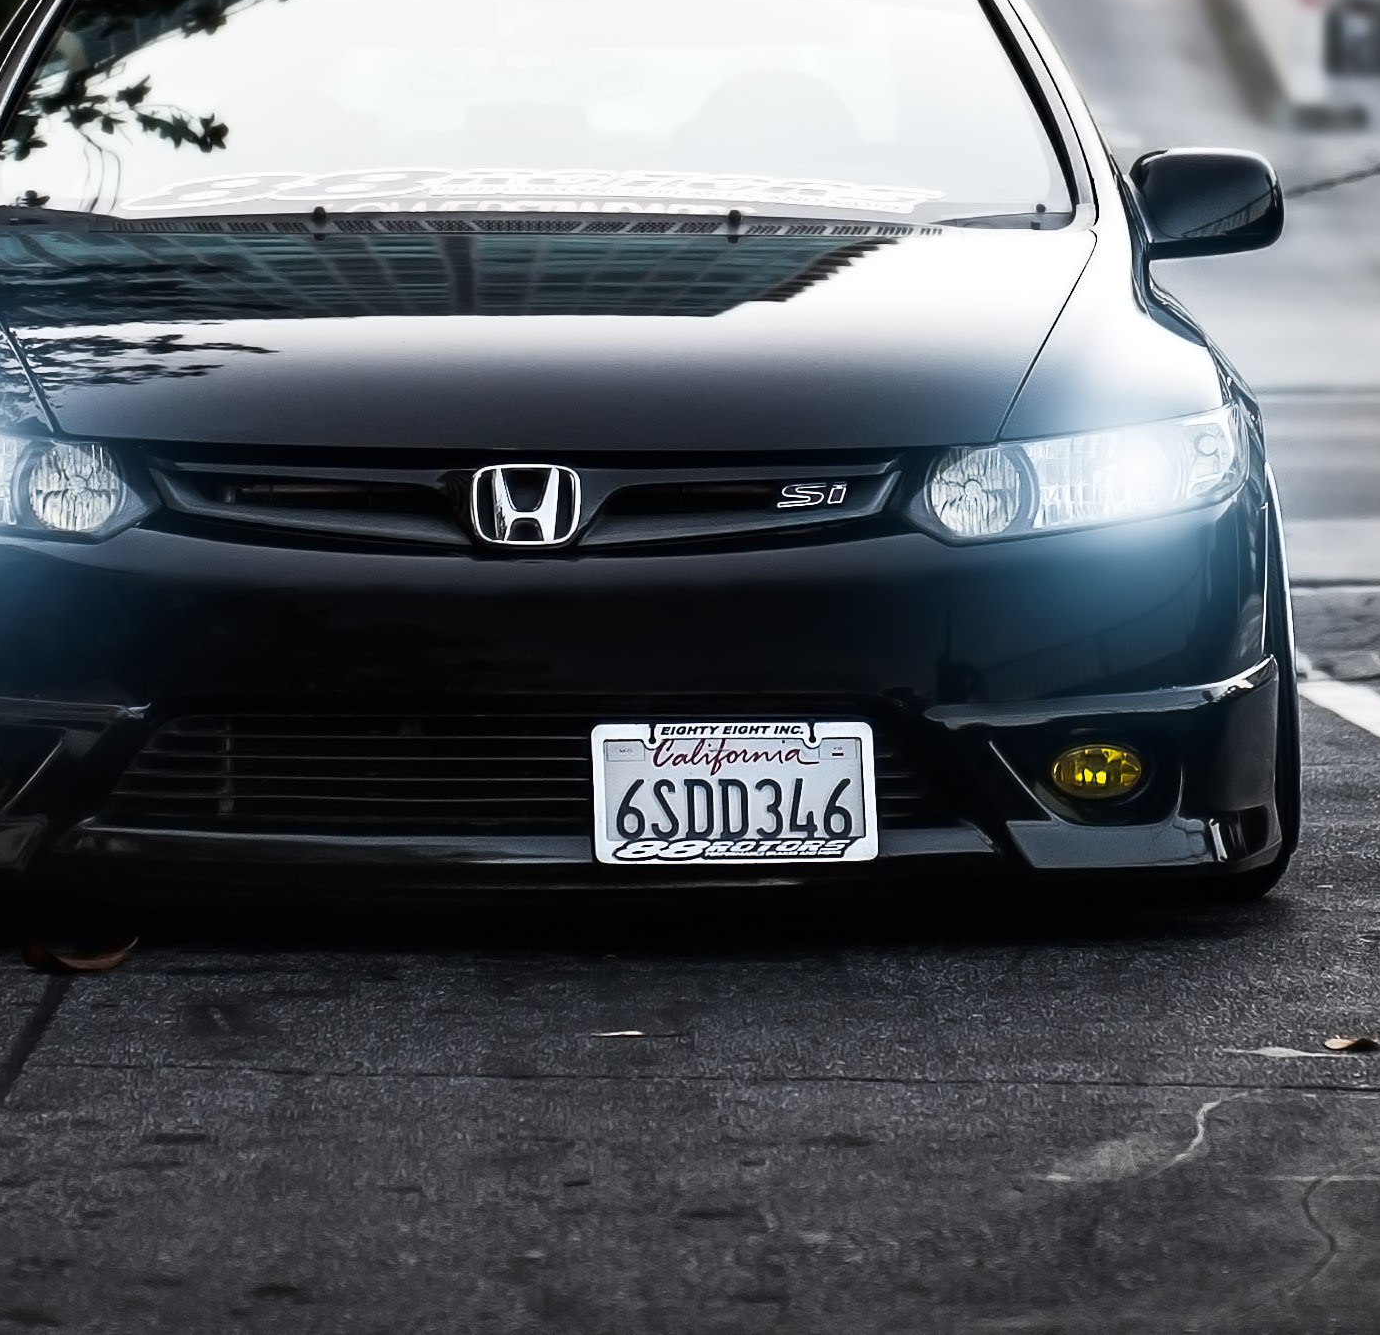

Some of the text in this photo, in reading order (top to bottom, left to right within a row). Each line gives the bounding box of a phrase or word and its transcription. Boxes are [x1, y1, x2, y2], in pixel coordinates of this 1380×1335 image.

[661, 725, 805, 736] EIGHTY EIGHT INC.
[652, 738, 820, 776] California
[616, 777, 853, 840] 6SDD346
[615, 840, 711, 859] 88
